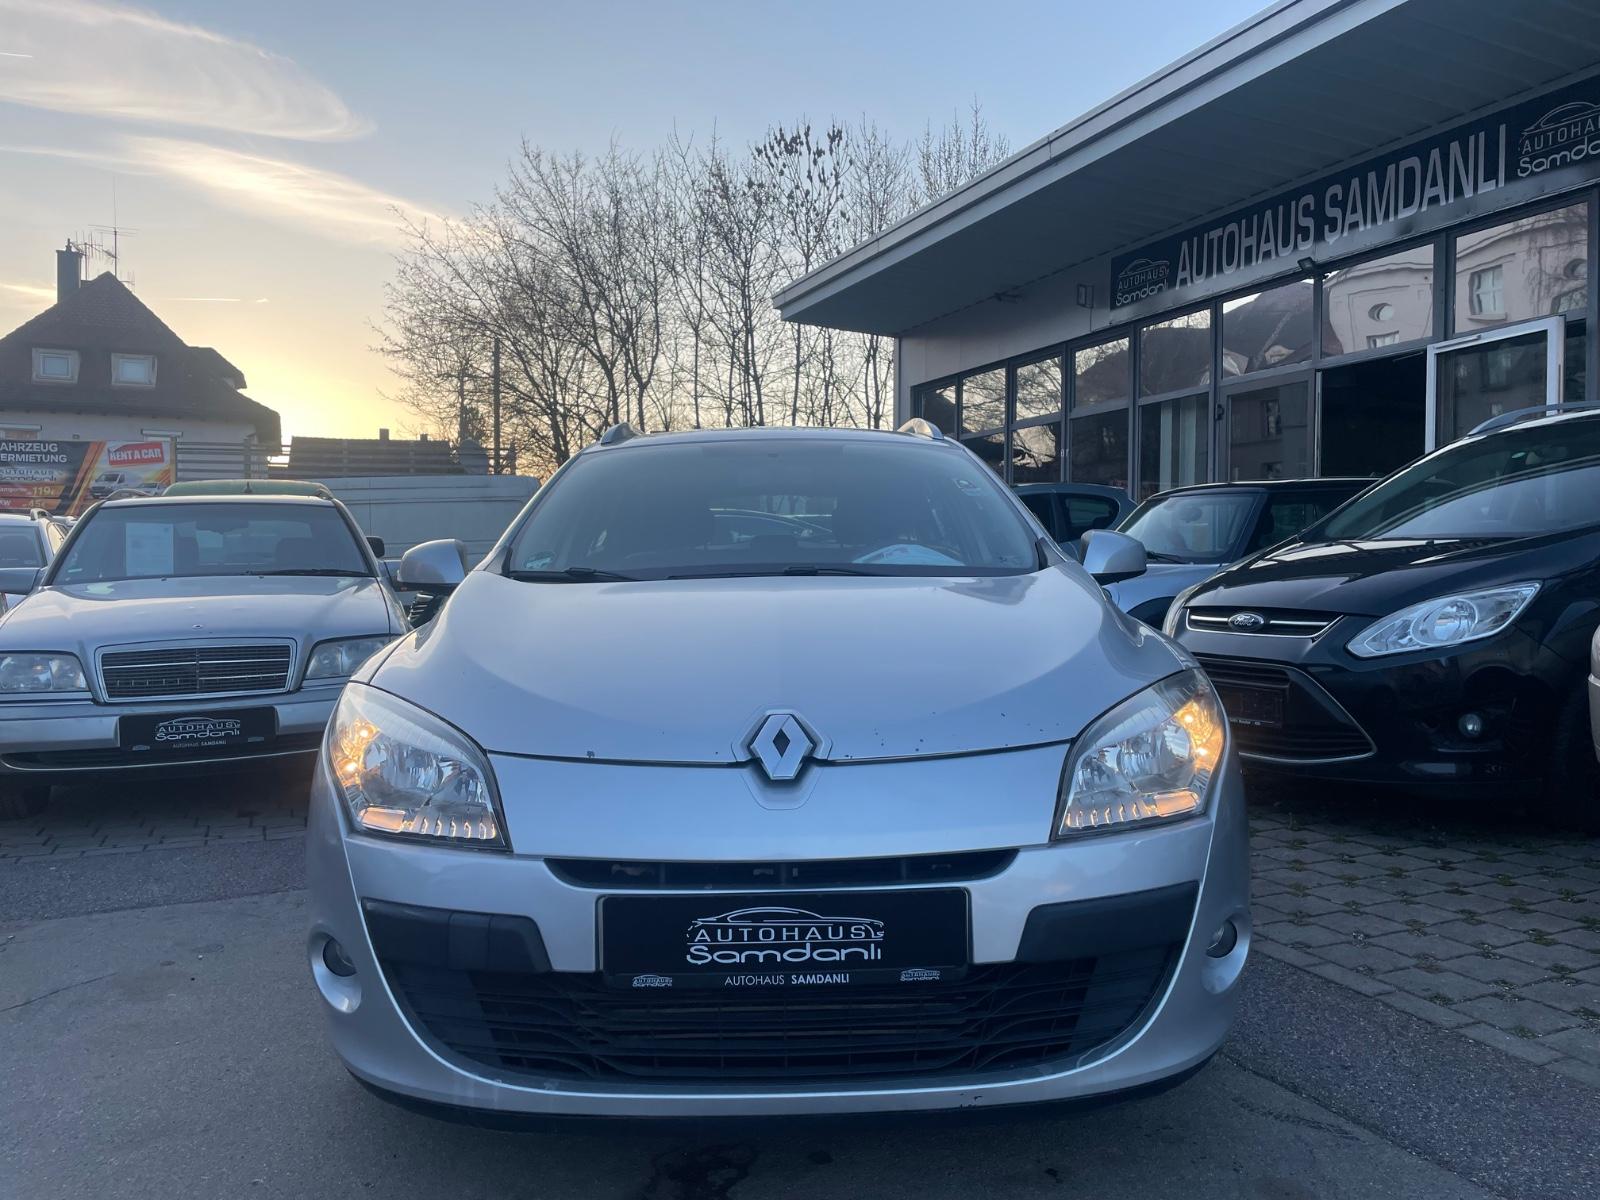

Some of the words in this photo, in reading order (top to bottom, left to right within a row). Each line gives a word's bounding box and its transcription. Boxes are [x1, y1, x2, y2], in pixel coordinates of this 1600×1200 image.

[1522, 115, 1600, 154] AUTOHA
[1175, 194, 1315, 290] AUTOHAUS
[1118, 266, 1166, 290] AUTOHAUS
[1233, 612, 1255, 627] Ford
[159, 721, 233, 733] AUTOHAUS
[694, 925, 866, 943] AUTOHAUS
[724, 975, 785, 986] AUTOHAUS
[791, 973, 850, 985] SAMDANLI
